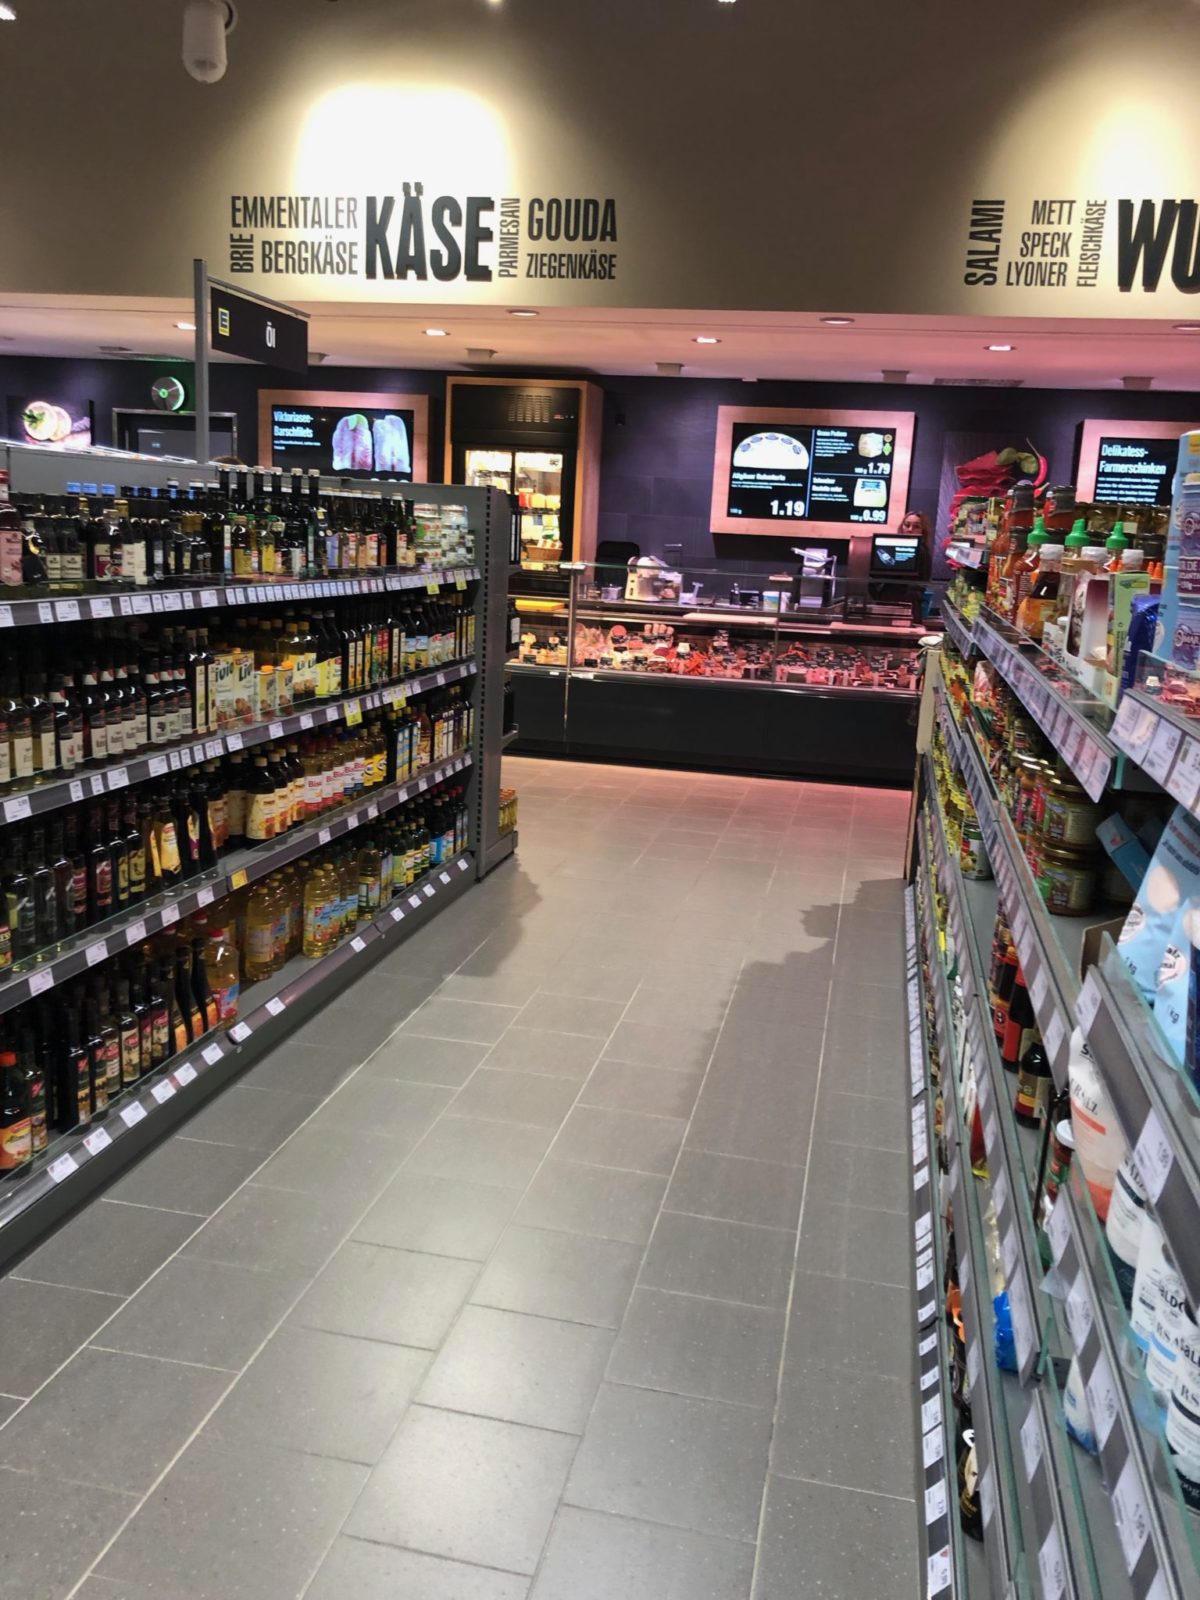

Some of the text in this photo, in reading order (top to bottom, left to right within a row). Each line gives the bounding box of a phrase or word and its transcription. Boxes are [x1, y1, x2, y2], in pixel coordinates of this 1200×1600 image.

[231, 195, 358, 229] EMMENTALER
[527, 197, 617, 242] GOUDA
[1031, 200, 1076, 225] METT
[365, 182, 495, 281] KÄSE
[498, 197, 521, 278] PARMESAN
[964, 200, 1005, 286] SALAMI
[1020, 232, 1072, 258] SPECK
[1076, 200, 1107, 287] FLEISCHKÄSE
[230, 233, 254, 273] BRIE
[261, 235, 358, 275] BERGKÄSE
[526, 249, 617, 280] ZIEGENKÄSE
[1006, 261, 1068, 287] LYONER
[266, 321, 276, 348] Öl
[1101, 444, 1149, 457] Delikatess-
[867, 462, 891, 475] 1.79
[1099, 460, 1167, 474] Farmerschinken
[770, 500, 805, 517] 1.19
[863, 509, 887, 522] 0.99
